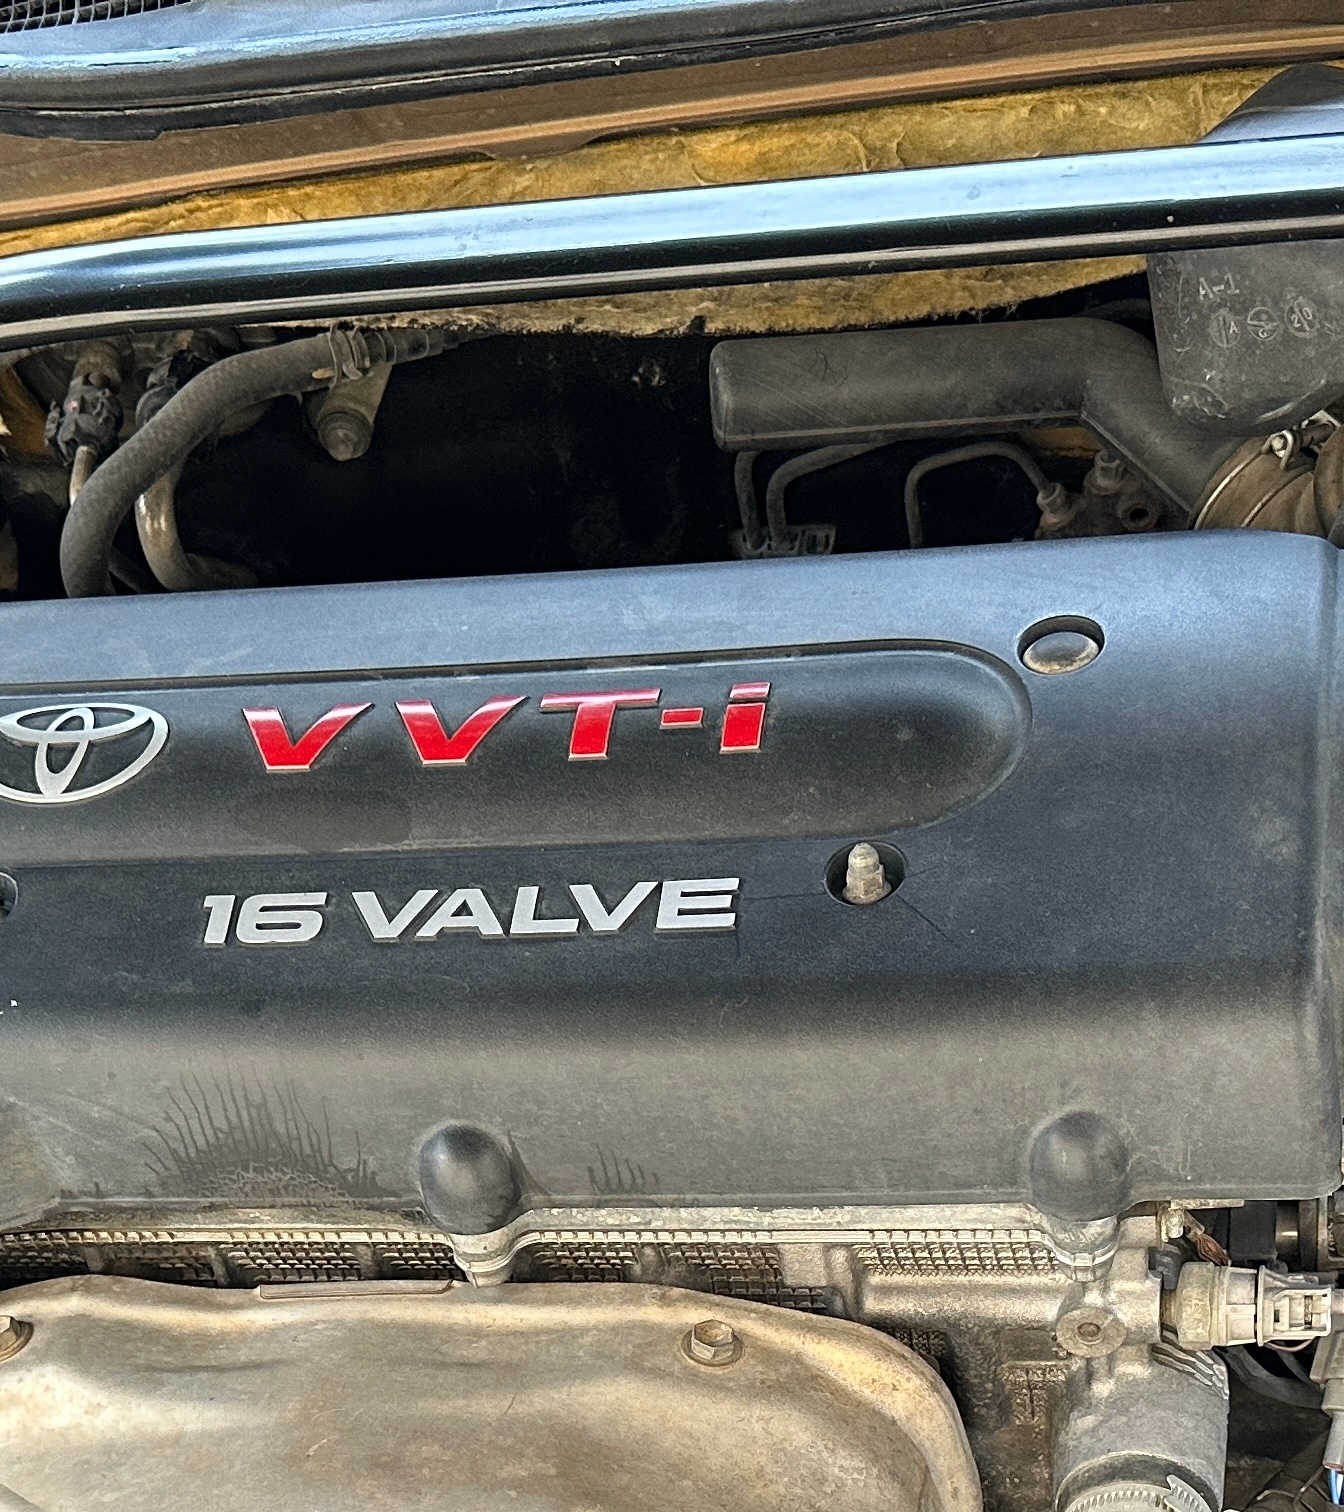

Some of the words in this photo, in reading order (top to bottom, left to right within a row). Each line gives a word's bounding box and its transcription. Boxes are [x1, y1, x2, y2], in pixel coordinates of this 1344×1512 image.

[1198, 272, 1239, 301] A-1
[202, 890, 329, 948] 16
[350, 876, 740, 942] VALVE
